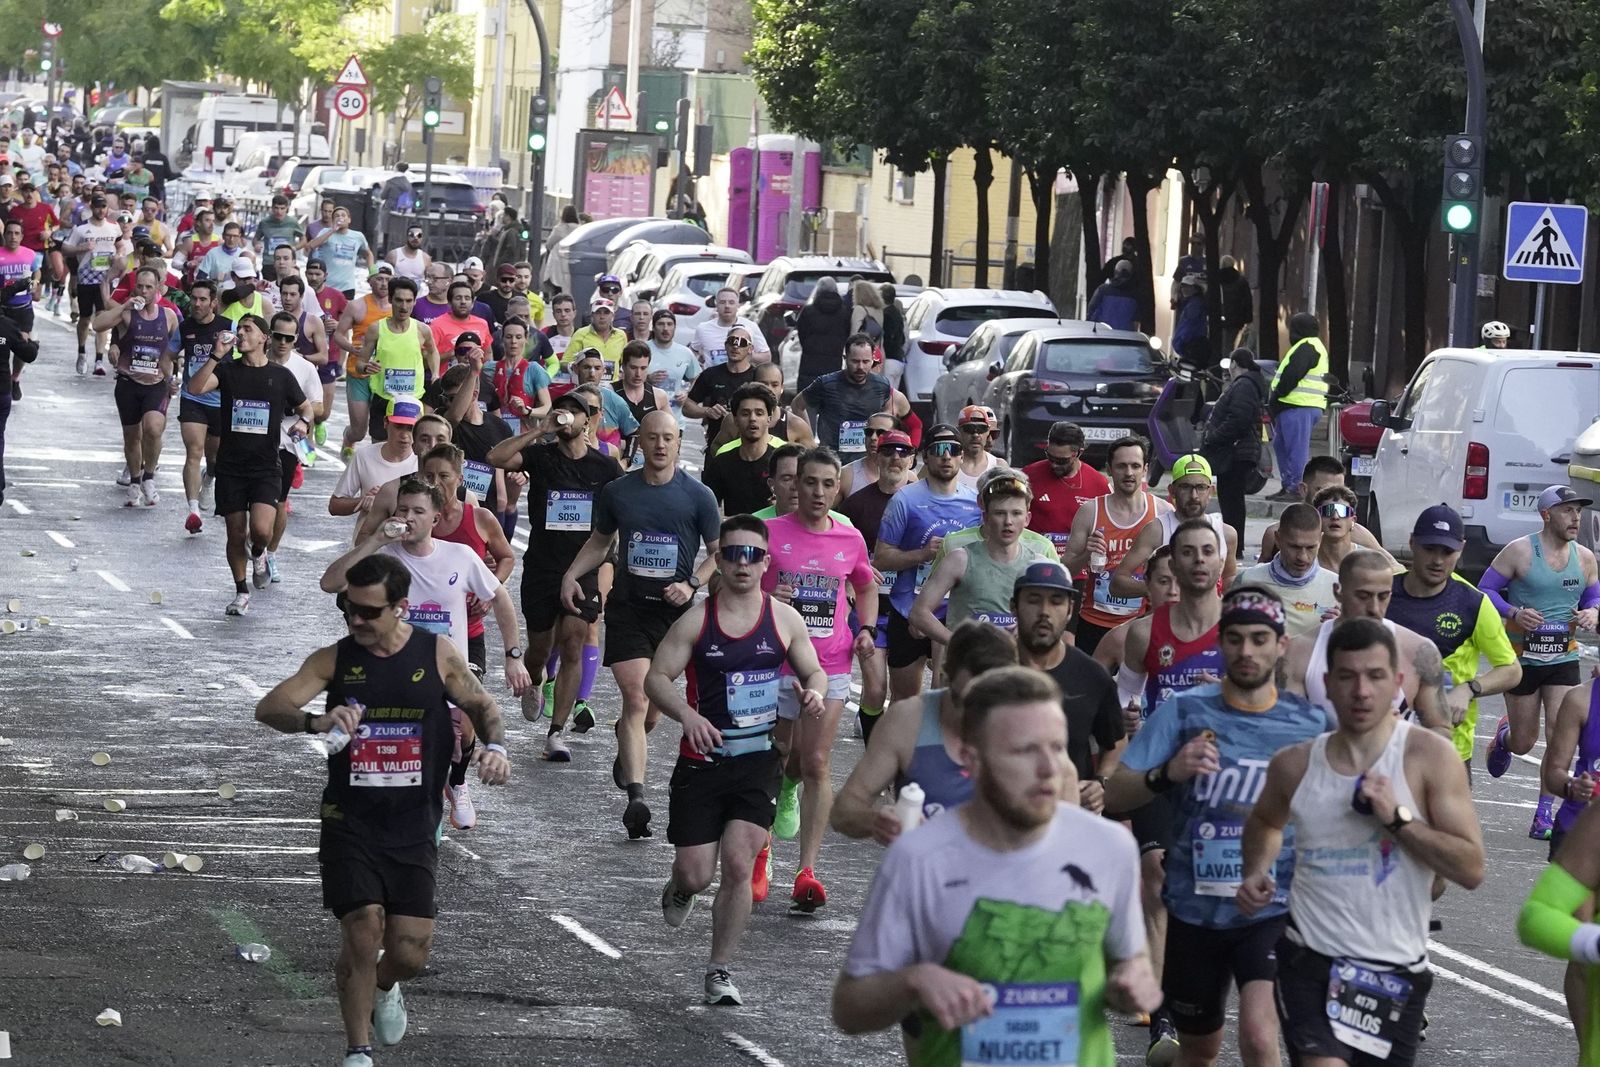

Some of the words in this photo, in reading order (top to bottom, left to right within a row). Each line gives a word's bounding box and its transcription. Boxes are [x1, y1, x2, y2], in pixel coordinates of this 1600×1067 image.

[341, 97, 361, 109] 30
[132, 359, 158, 368] ROBERTO
[236, 417, 264, 426] MARTIN
[1083, 429, 1106, 439] 249
[469, 463, 490, 472] ZURICH
[461, 480, 485, 492] ONRAD
[562, 492, 588, 500] ZURICH
[558, 512, 581, 521] SOSO
[645, 535, 673, 543] ZURICH
[632, 556, 671, 567] KRISTOF
[1563, 579, 1580, 587] RUN
[802, 590, 832, 598] ZURICH
[801, 604, 819, 613] 5239
[414, 612, 443, 620] ZURICH
[993, 616, 1017, 624] ZURIC
[803, 615, 834, 627] ANDRO
[1440, 621, 1457, 630] ACV
[1529, 643, 1564, 653] WHEATS
[748, 671, 776, 682] ZURICH
[749, 689, 765, 698] 6324
[375, 727, 414, 736] ZURICH
[376, 745, 397, 755] 1398
[351, 761, 381, 772] CALIL
[383, 760, 422, 772] VALOTO
[1003, 988, 1069, 1004] ZURICH
[1340, 1006, 1382, 1035] MILOS
[978, 1039, 1063, 1061] NUGGET
